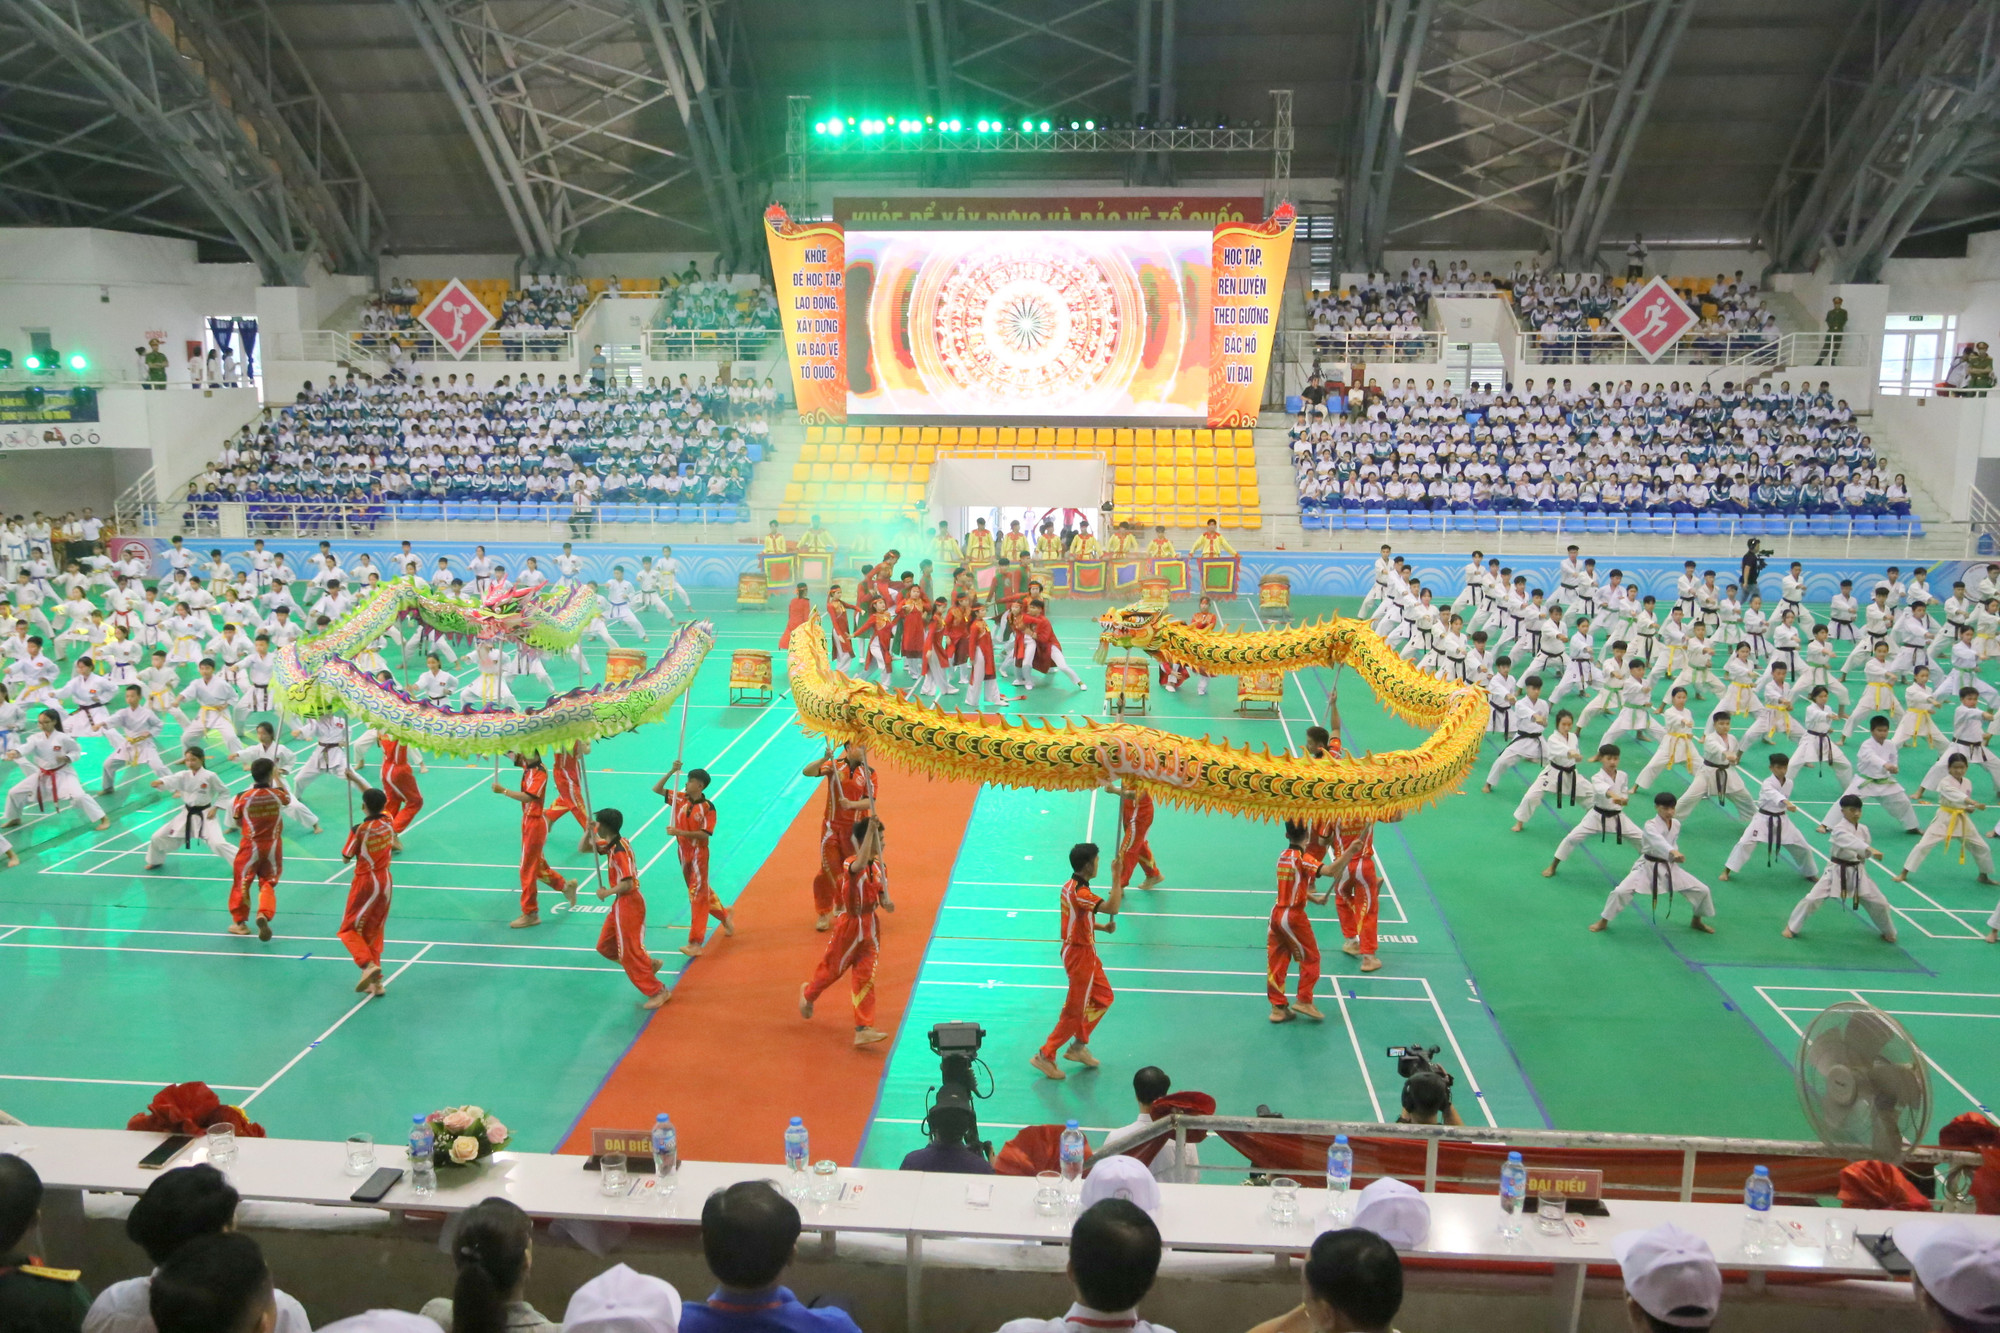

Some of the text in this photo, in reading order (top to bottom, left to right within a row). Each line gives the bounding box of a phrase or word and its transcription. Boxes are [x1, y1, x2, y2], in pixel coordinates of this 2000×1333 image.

[805, 245, 827, 263] KHỎE
[1224, 245, 1262, 269] HỌC TẬP,
[793, 267, 842, 290] ĐỂ HỌC TẬP,
[1218, 275, 1266, 298] RÈN LUYỆN
[795, 294, 838, 312] LAO ĐỘNG,
[1214, 306, 1269, 324] THEO GƯƠNG
[797, 317, 838, 336] XÂY DỰNG
[796, 338, 839, 359] VÀ BẢO VỆ
[1224, 333, 1242, 353] BÁC
[801, 360, 835, 380] TỔ QUỐC
[1238, 366, 1252, 386] ĐẠI
[1528, 1175, 1586, 1193] ĐẠI BIỂU
